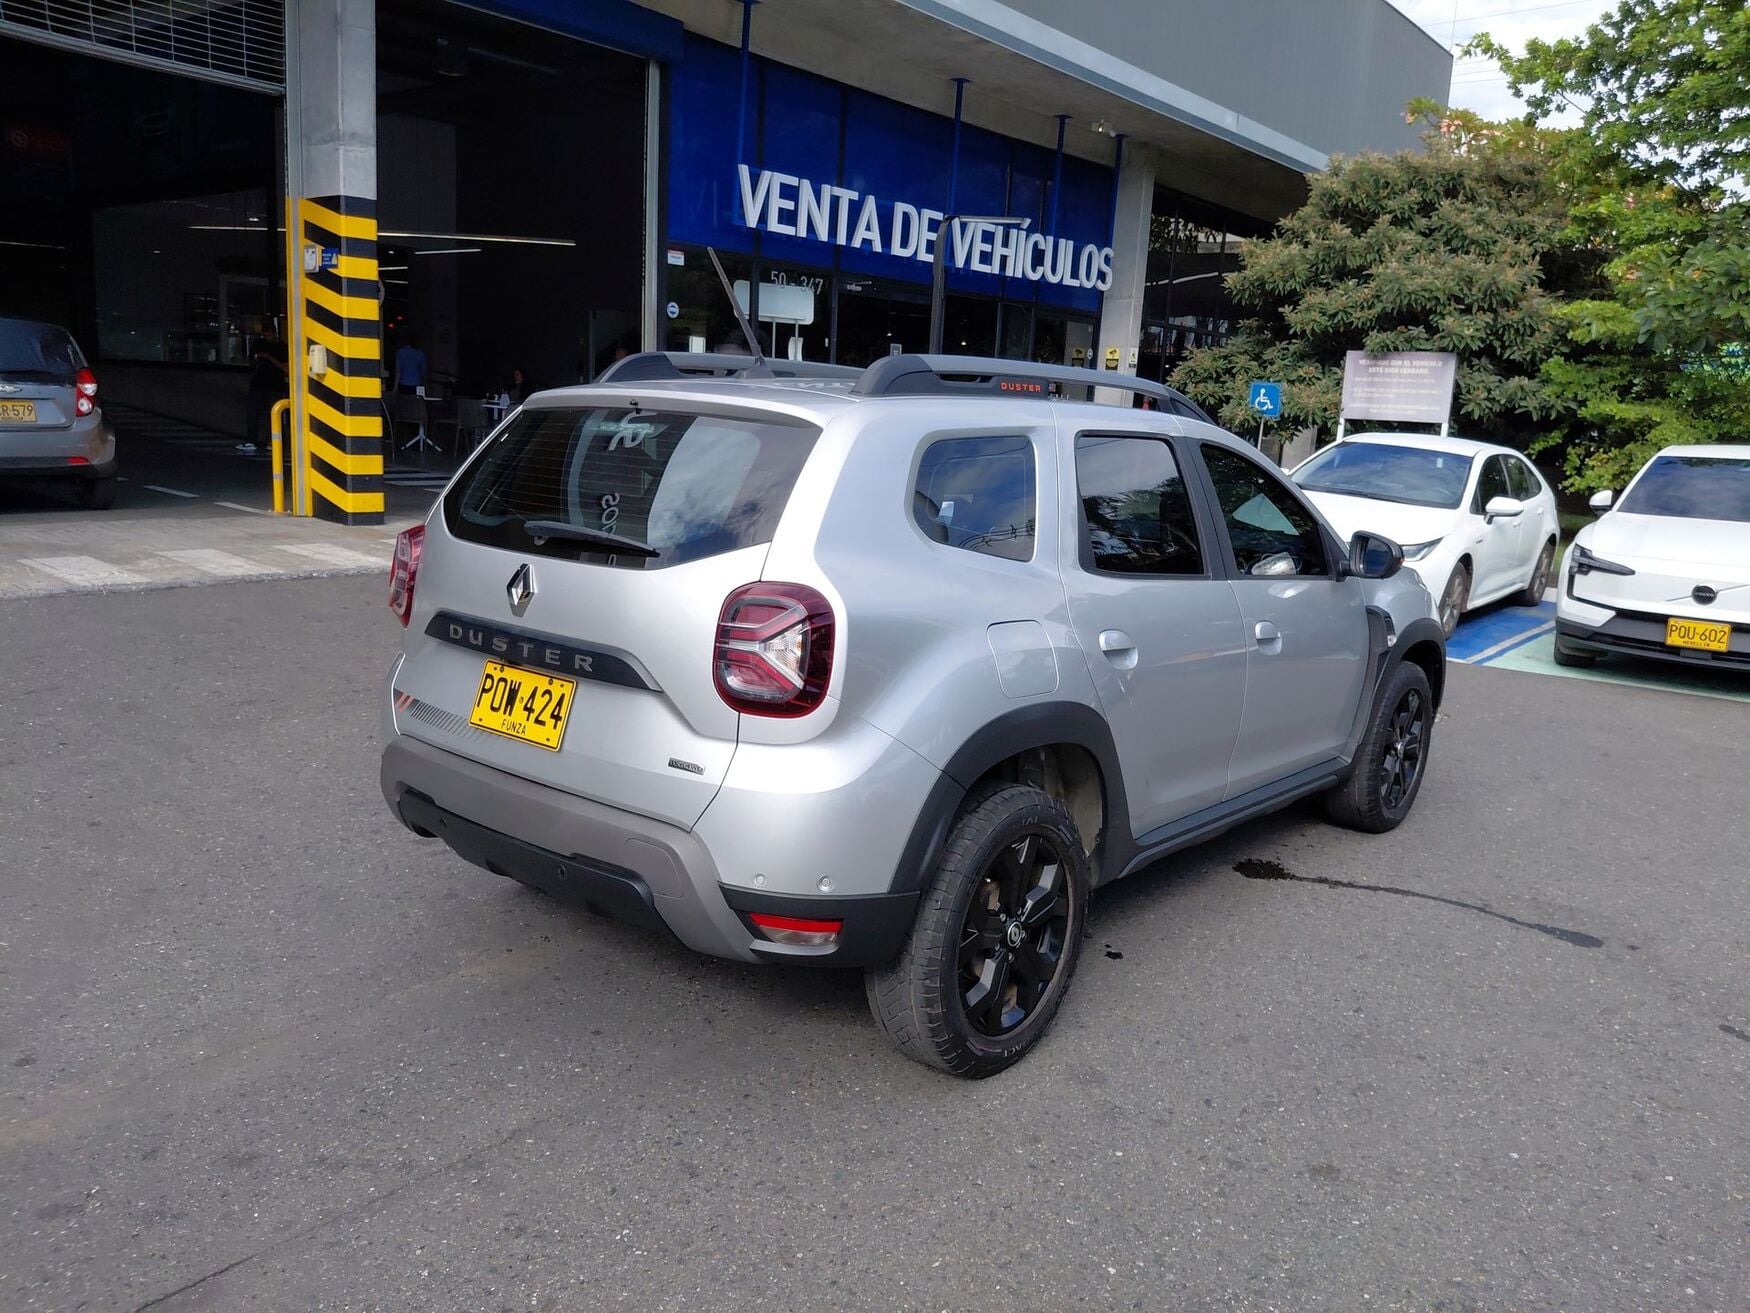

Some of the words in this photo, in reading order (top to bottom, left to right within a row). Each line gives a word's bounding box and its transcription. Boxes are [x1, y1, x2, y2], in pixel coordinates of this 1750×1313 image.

[737, 163, 883, 253] VENTA
[891, 201, 944, 263] DE
[950, 215, 1114, 292] VEHÍCULOS
[771, 270, 787, 289] 50
[800, 275, 824, 295] 347
[1001, 382, 1041, 393] DUSTER
[449, 624, 593, 672] DUSTER
[501, 718, 527, 735] FUNZA
